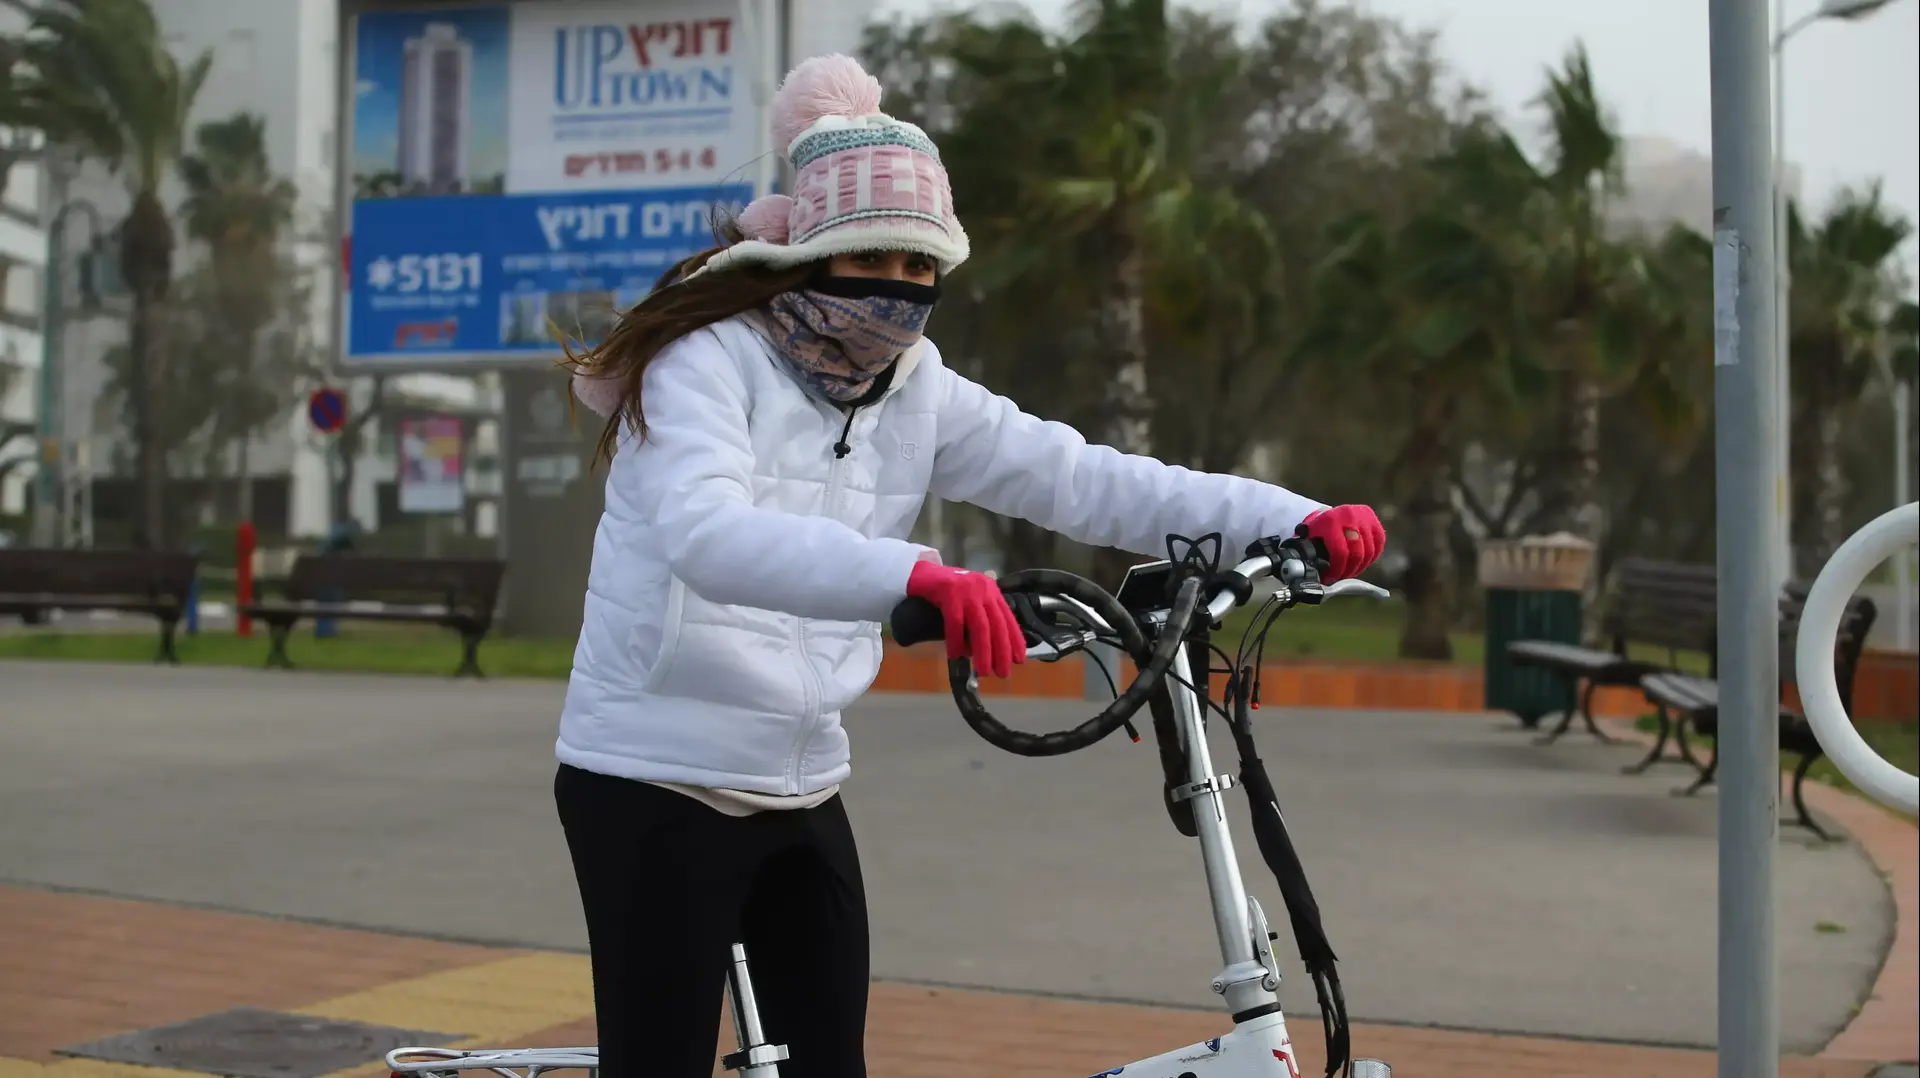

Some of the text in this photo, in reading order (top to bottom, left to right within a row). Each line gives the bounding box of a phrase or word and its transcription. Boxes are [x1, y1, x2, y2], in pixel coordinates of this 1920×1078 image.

[628, 17, 732, 67] דוניץ
[556, 25, 624, 109] UP
[608, 66, 733, 105] TOWN
[537, 203, 631, 249] דוניץ
